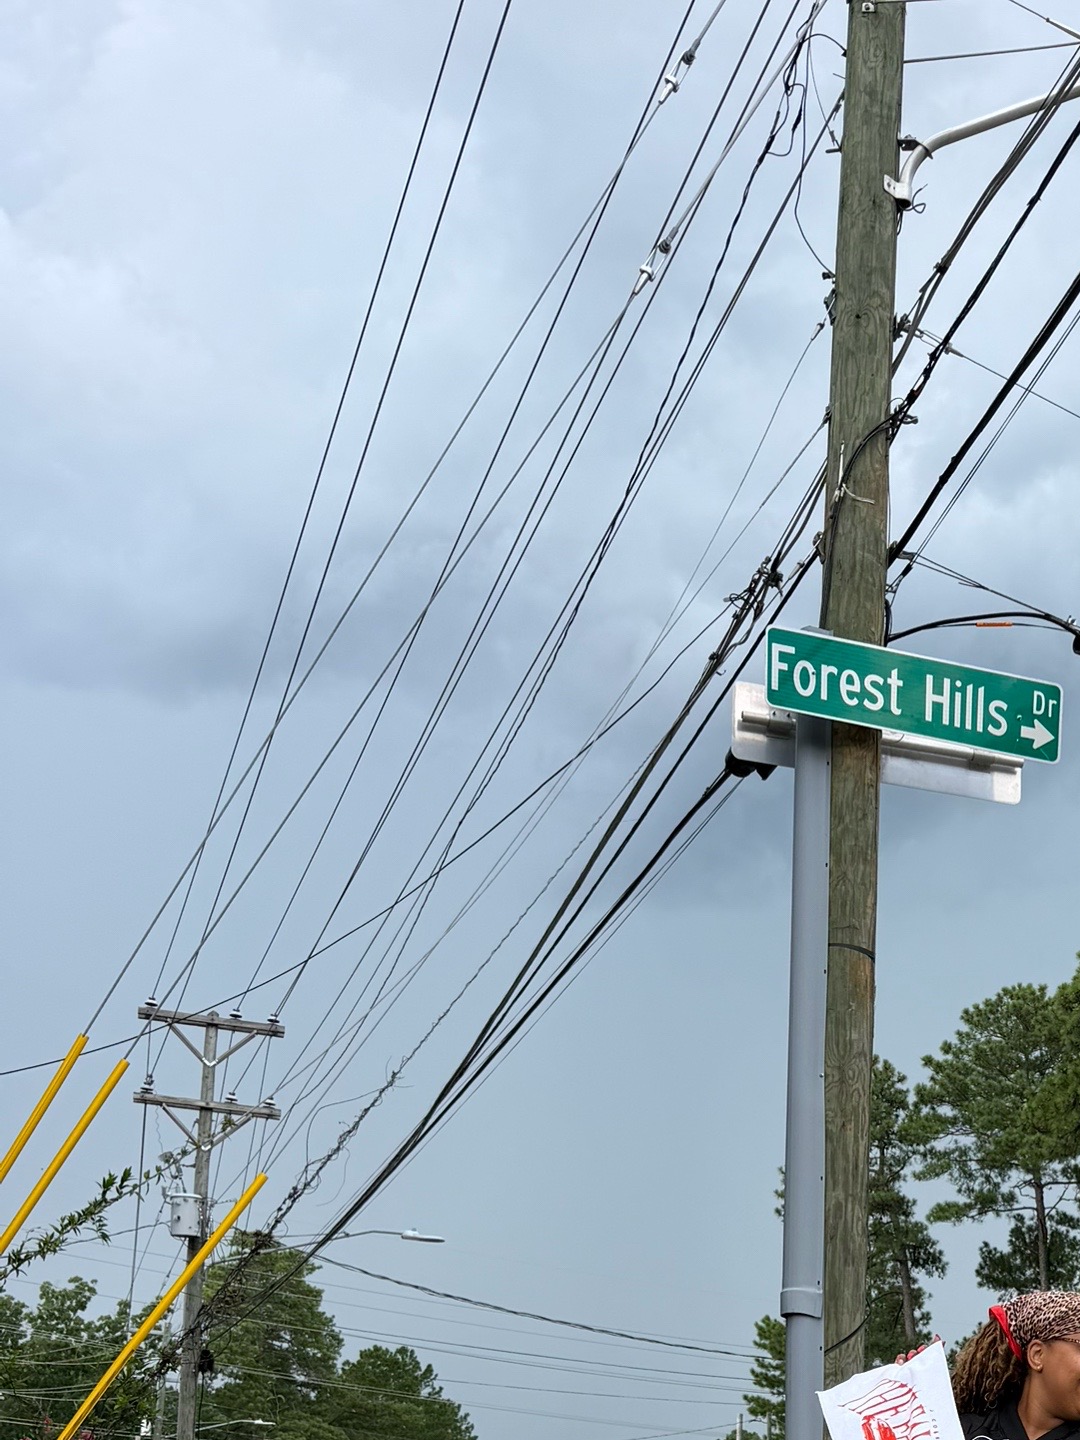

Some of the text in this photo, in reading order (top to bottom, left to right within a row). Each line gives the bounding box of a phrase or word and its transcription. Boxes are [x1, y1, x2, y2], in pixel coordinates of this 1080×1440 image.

[771, 643, 1057, 737] Forest Hills Dr
